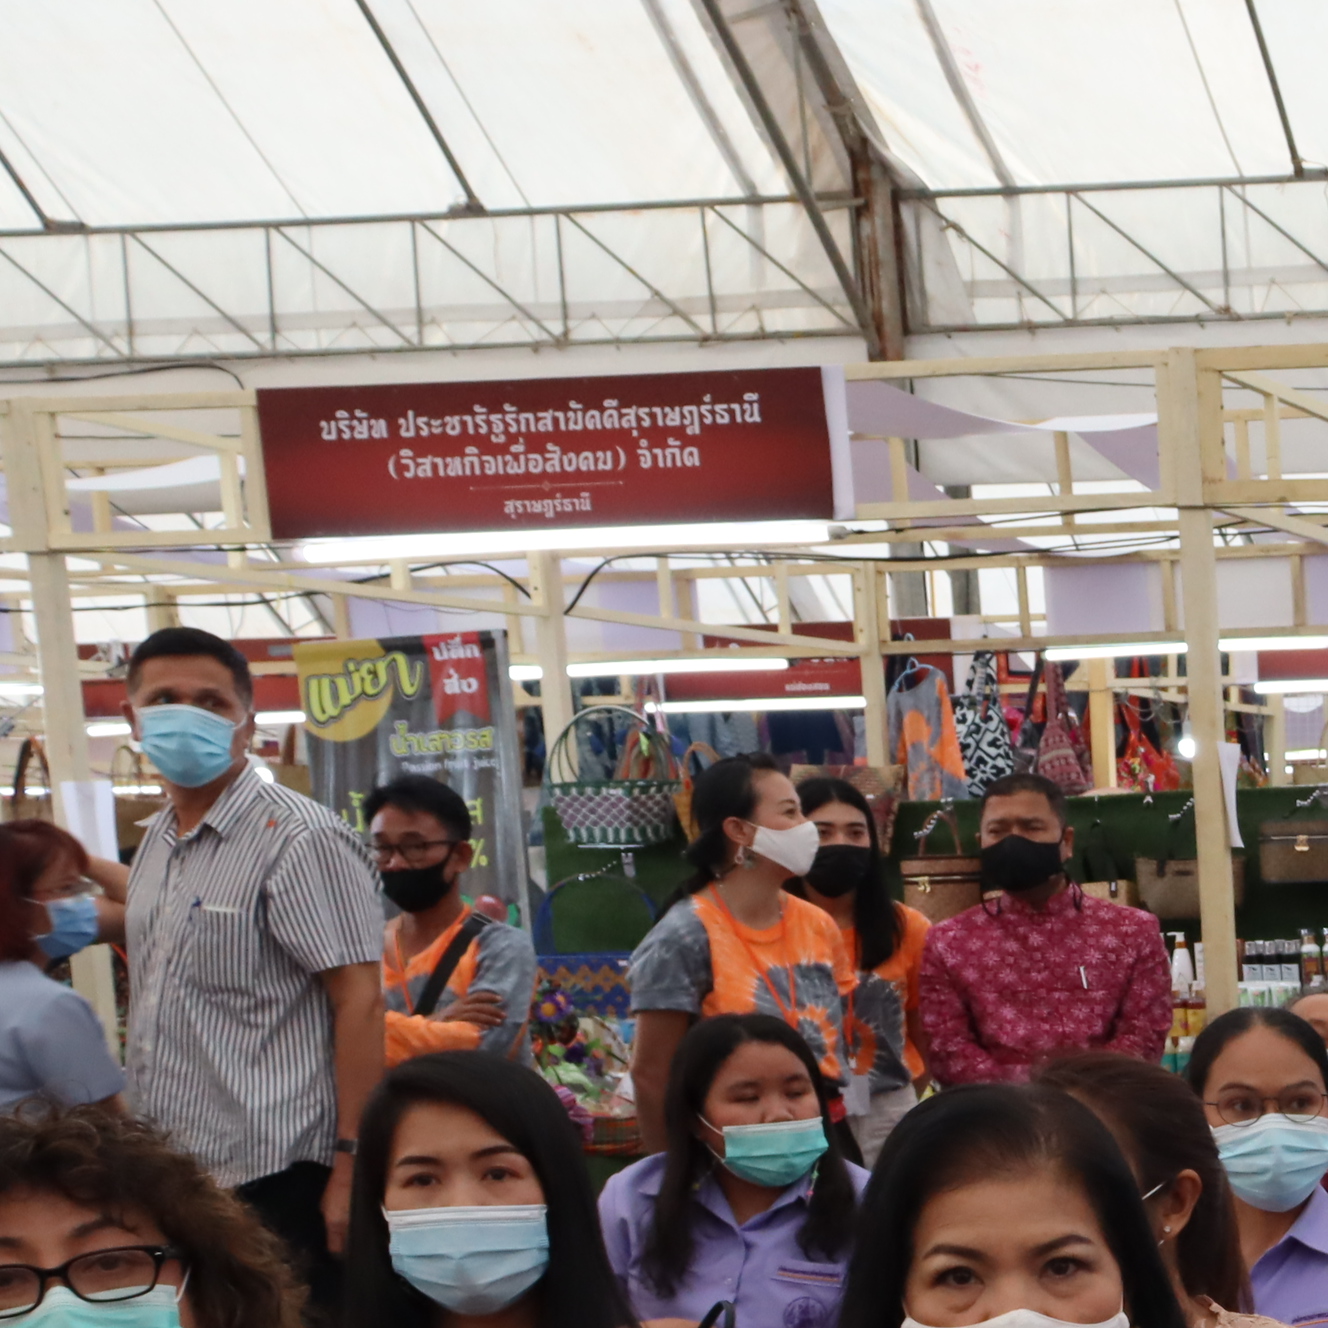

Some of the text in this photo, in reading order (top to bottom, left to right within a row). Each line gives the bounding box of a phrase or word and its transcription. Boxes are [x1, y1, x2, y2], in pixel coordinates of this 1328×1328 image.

[319, 393, 761, 444] บริษัท ประชารัฐรักสามัคคีสุราษฎร์ธานี
[388, 438, 700, 481] (วิสาหกิจเพื่อสังคม) จำกัด
[504, 493, 592, 518] สุราษฎร์ธานี
[443, 668, 480, 695] ส่ง
[390, 719, 495, 757] น้ำเสาวรส
